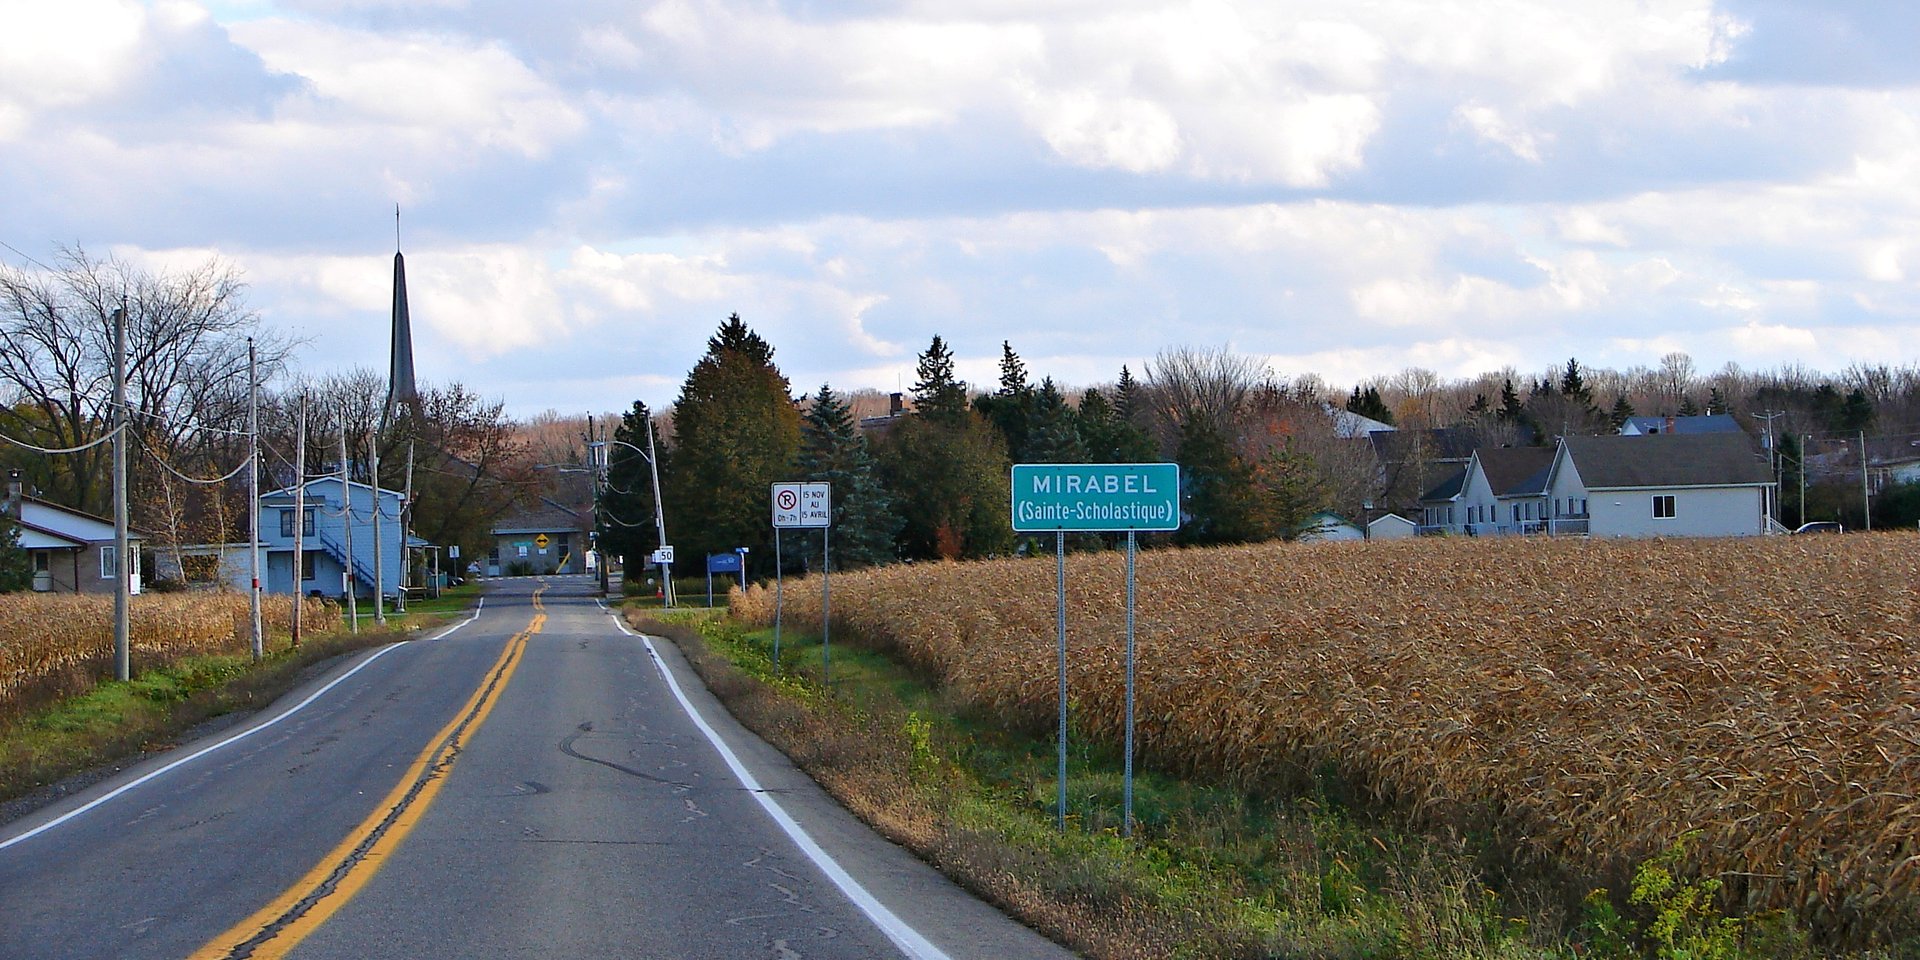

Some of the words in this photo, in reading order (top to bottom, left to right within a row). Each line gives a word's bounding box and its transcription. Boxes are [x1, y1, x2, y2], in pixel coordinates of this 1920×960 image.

[1033, 475, 1157, 494] MIRABEL
[803, 491, 809, 499] 15
[811, 491, 825, 499] NOV
[811, 501, 820, 509] AU
[801, 511, 808, 519] 15
[810, 511, 828, 519] AVRIL
[1018, 500, 1173, 524] (Sainte-Scholastique)
[661, 551, 672, 561] 50
